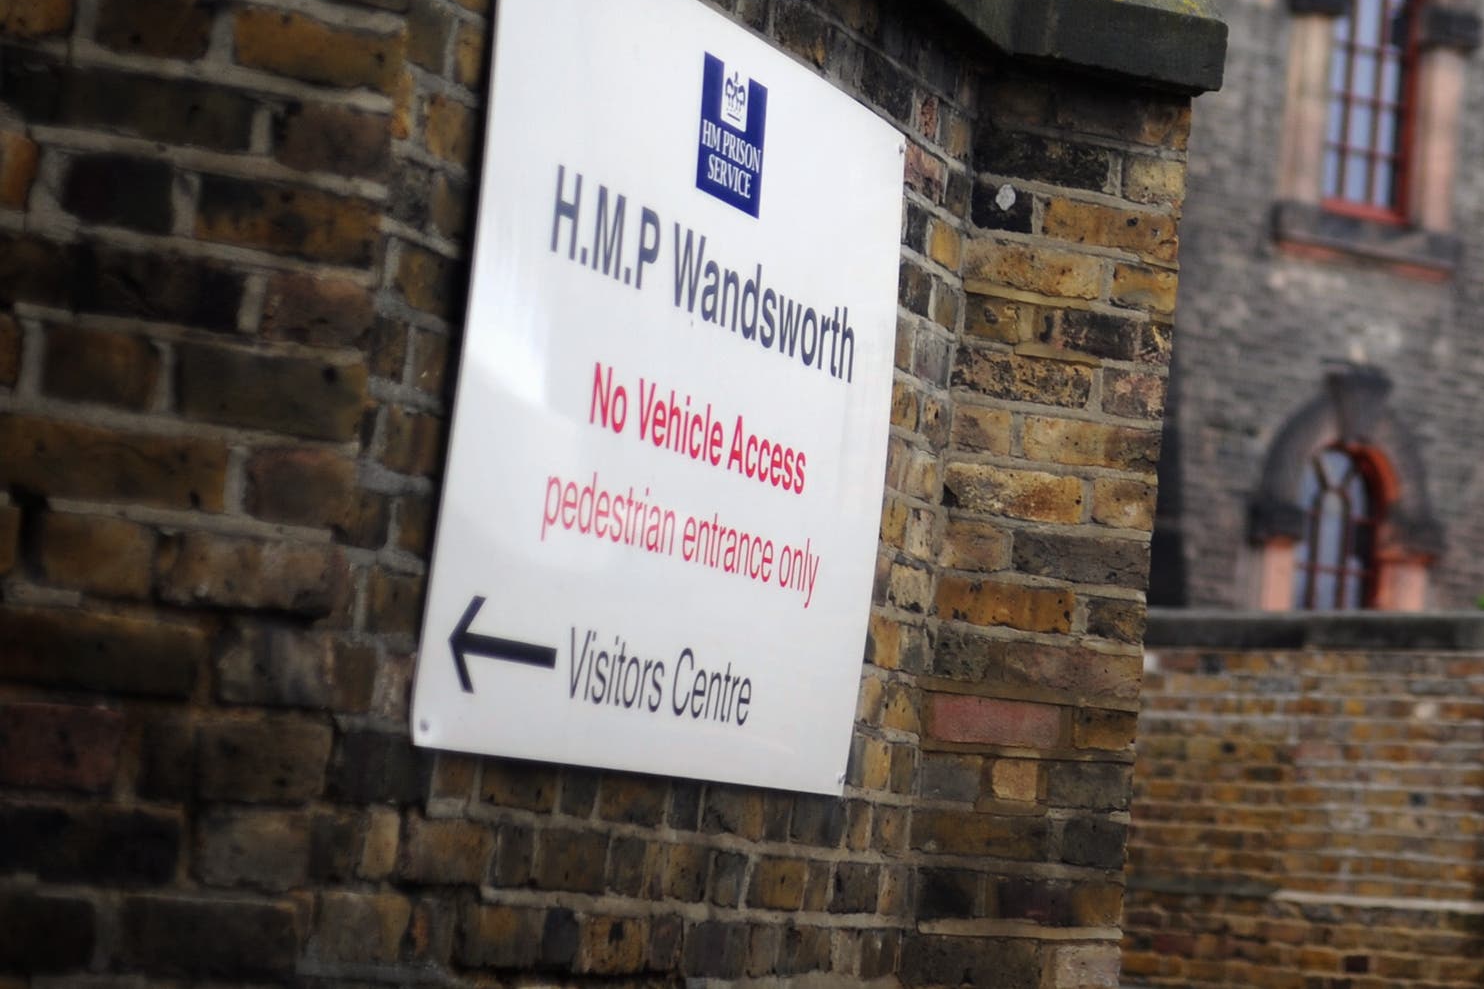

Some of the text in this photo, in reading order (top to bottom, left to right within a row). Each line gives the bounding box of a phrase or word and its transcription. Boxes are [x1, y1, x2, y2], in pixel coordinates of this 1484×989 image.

[702, 119, 761, 174] HM PRISON
[707, 153, 752, 199] SERVICE
[551, 165, 855, 385] H.M.P Wandsworth
[588, 361, 807, 496] No Vehicle Access
[540, 471, 820, 608] pedestrian entrance only
[569, 626, 752, 727] Visitors Centre
